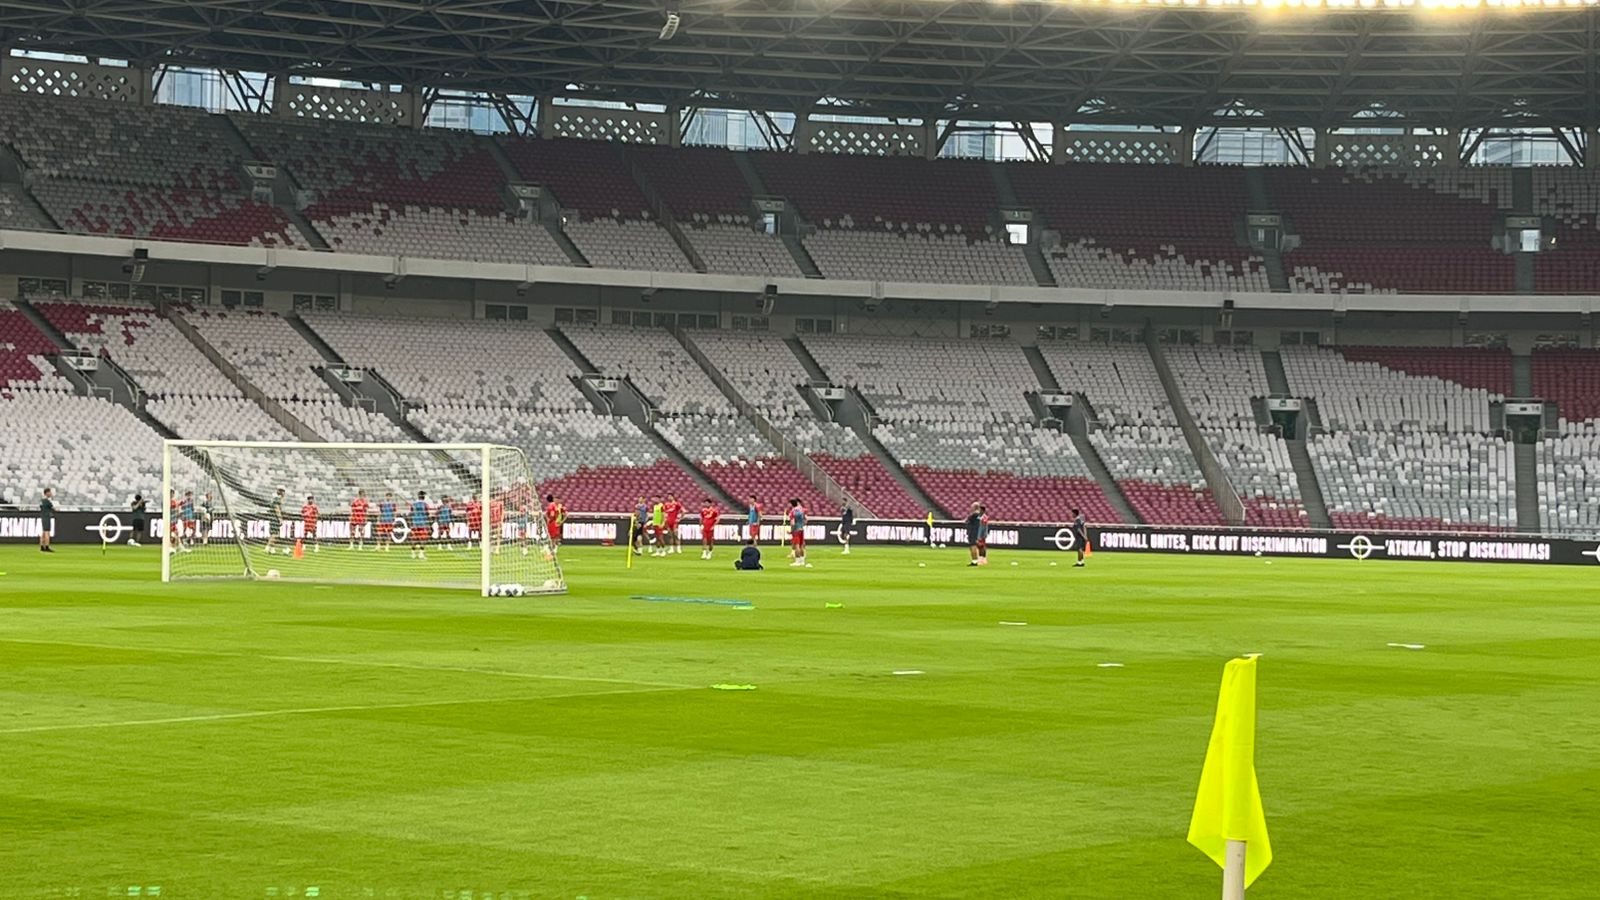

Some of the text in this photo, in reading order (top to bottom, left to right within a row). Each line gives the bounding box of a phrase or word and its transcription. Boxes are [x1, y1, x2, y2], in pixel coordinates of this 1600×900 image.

[930, 527, 952, 542] STOP
[1100, 532, 1327, 553] FOOTBALL UNITES, KICK OUT DISCRIMINATION
[1438, 541, 1465, 557] STOP
[1469, 543, 1550, 560] DISKRIMINASI
